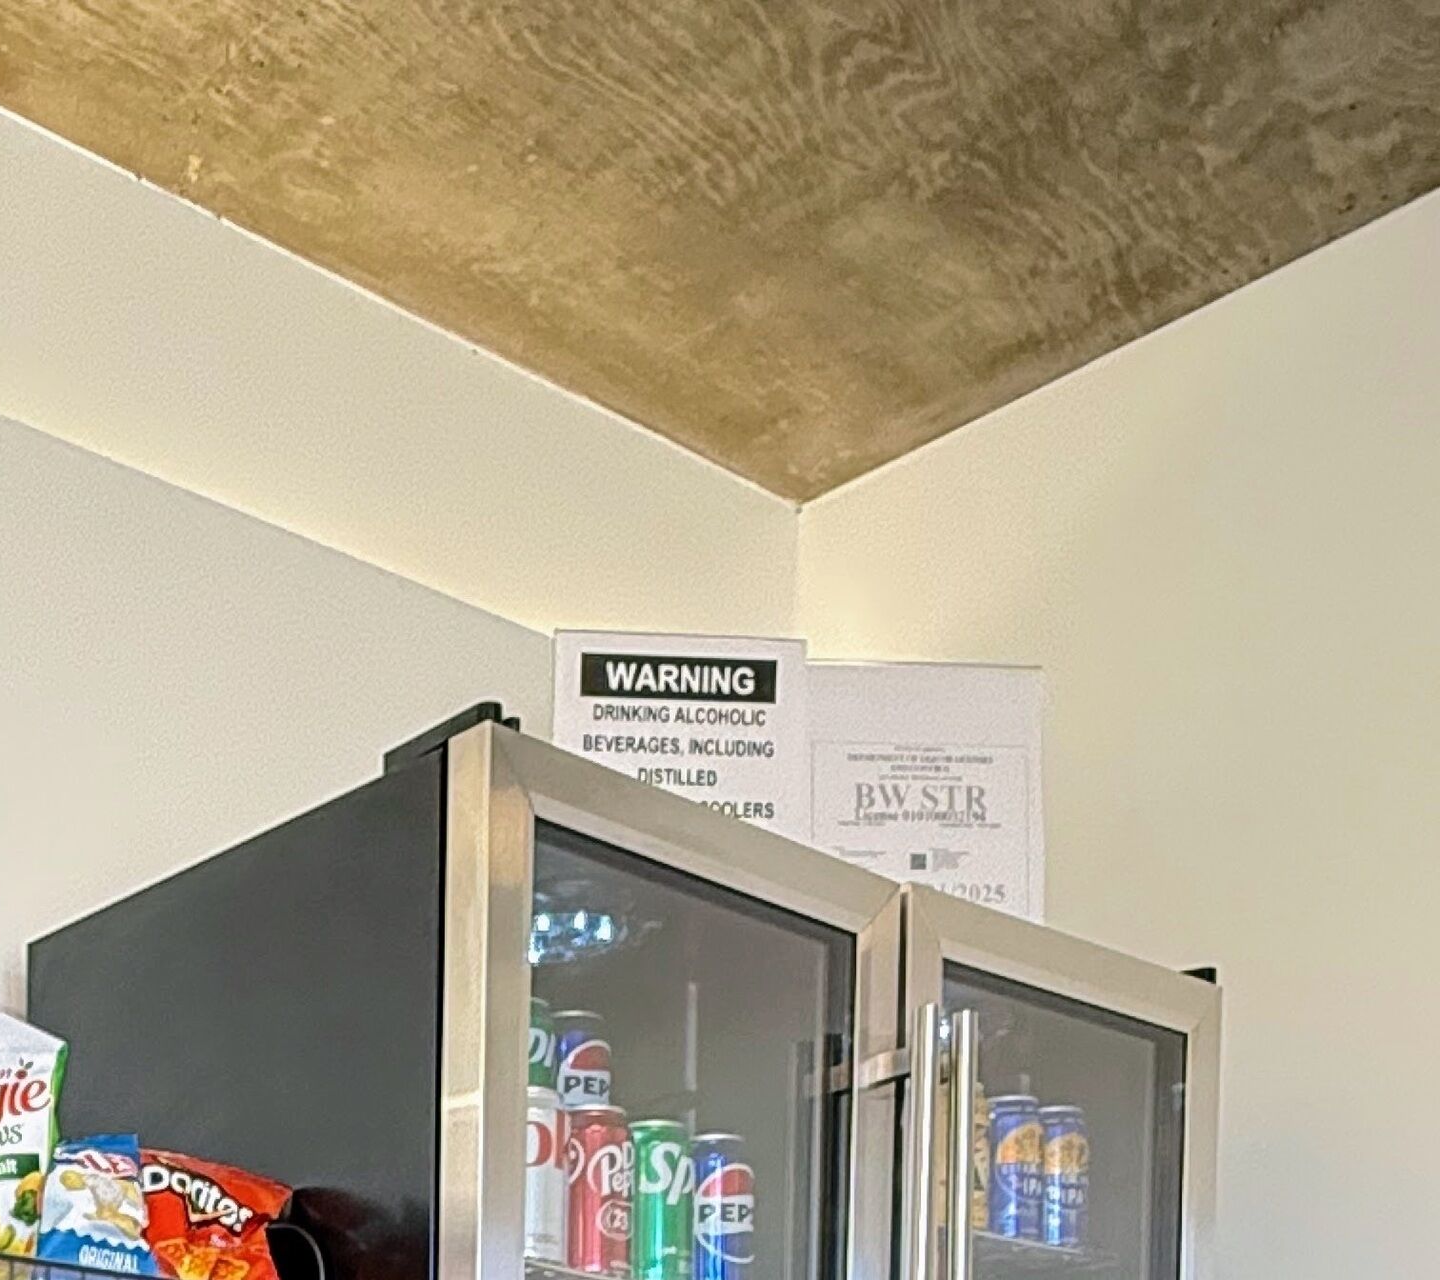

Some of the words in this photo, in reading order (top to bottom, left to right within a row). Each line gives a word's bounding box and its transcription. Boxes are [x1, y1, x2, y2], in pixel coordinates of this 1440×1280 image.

[606, 661, 756, 696] WARNING
[593, 703, 670, 723] DRINKING
[674, 706, 767, 727] ALCOHOLIC
[583, 734, 685, 756] BEVERAGES,
[689, 738, 774, 757] INCLUDING
[638, 766, 717, 786] DISTILLED
[700, 800, 774, 818] OOLERS
[854, 782, 910, 809] BW
[921, 785, 988, 814] STR
[143, 1163, 253, 1233] Doritos
[79, 1244, 140, 1272] ORIGINAL
